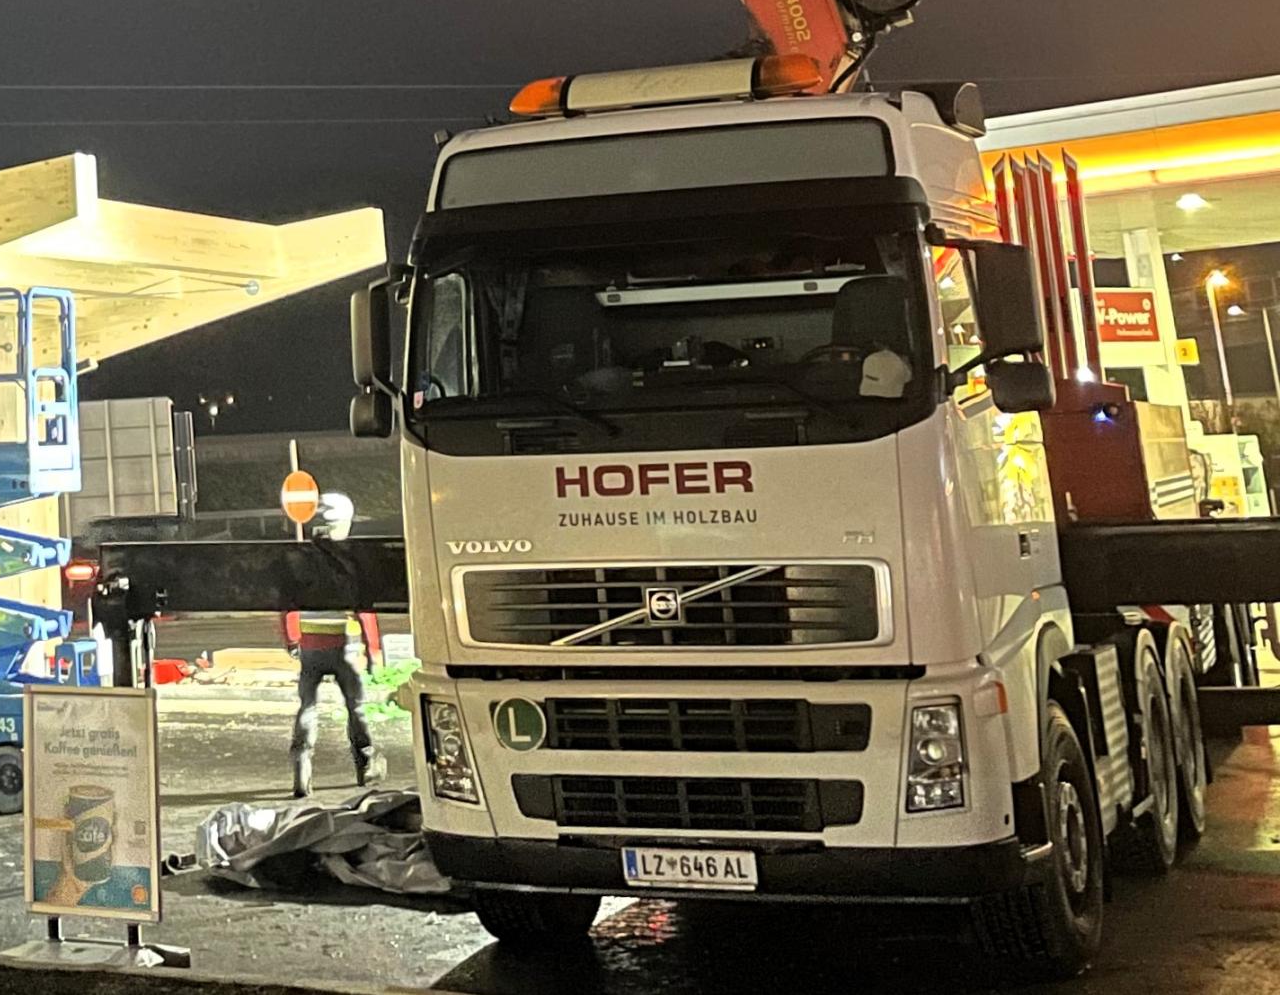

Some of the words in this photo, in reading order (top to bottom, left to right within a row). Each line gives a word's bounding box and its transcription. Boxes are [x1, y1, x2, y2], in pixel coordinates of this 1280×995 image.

[555, 461, 754, 498] HOFER
[558, 511, 639, 527] ZUHAUSE
[646, 511, 666, 525] IM
[673, 509, 758, 525] HOLZBAU
[445, 539, 532, 554] VOLVO
[60, 725, 85, 739] Jetzt
[88, 727, 120, 742] gratis
[508, 707, 531, 742] L
[44, 741, 80, 755] Kaffee
[83, 743, 137, 759] genießen!
[642, 854, 665, 875] LZ
[680, 856, 717, 878] 646
[724, 857, 748, 878] AL
